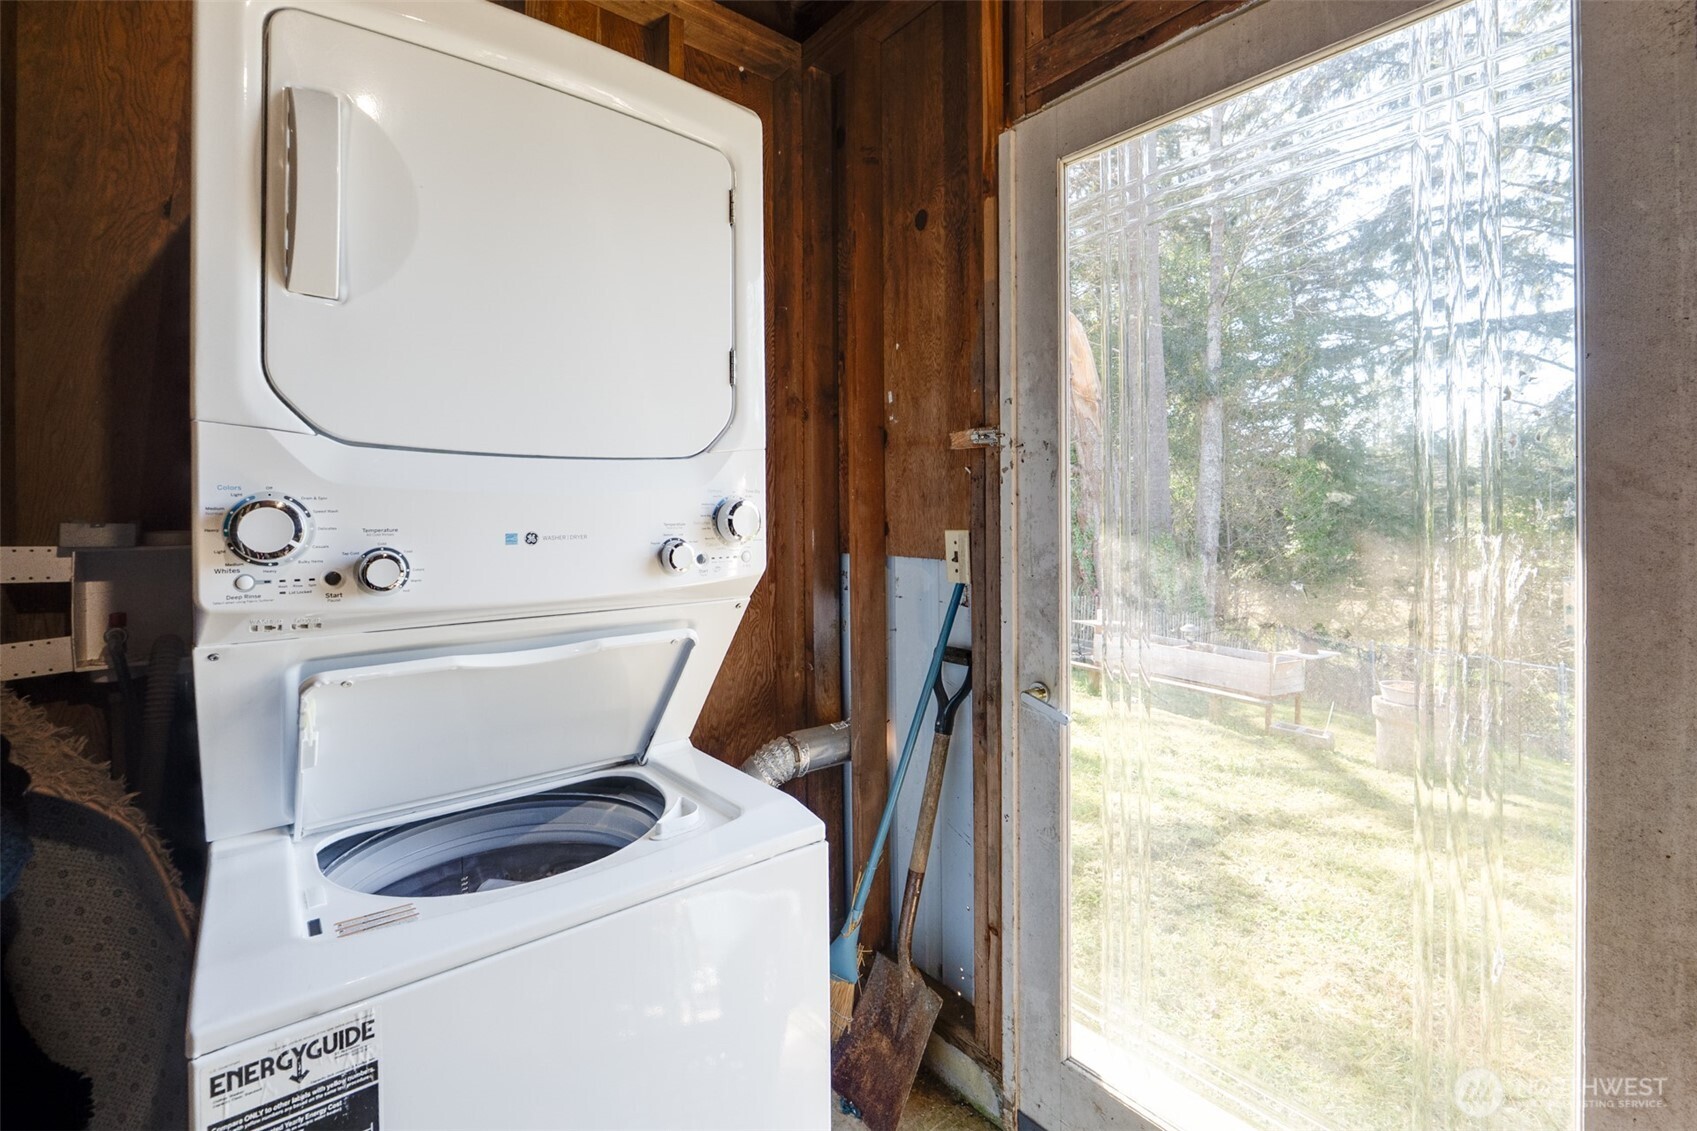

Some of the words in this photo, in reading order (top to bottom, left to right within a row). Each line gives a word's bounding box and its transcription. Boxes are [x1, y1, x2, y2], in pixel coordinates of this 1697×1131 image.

[217, 484, 242, 492] Colors
[214, 567, 241, 575] Whites
[211, 1118, 243, 1131] Compare
[244, 1109, 264, 1121] ONLY
[265, 1106, 272, 1114] to
[273, 1100, 291, 1111] other
[292, 1091, 311, 1104] labels
[312, 1085, 326, 1095] with
[326, 1078, 347, 1090] yellow
[284, 1116, 304, 1129] Yearly
[305, 1106, 327, 1120] Energy
[328, 1100, 342, 1111] Cost
